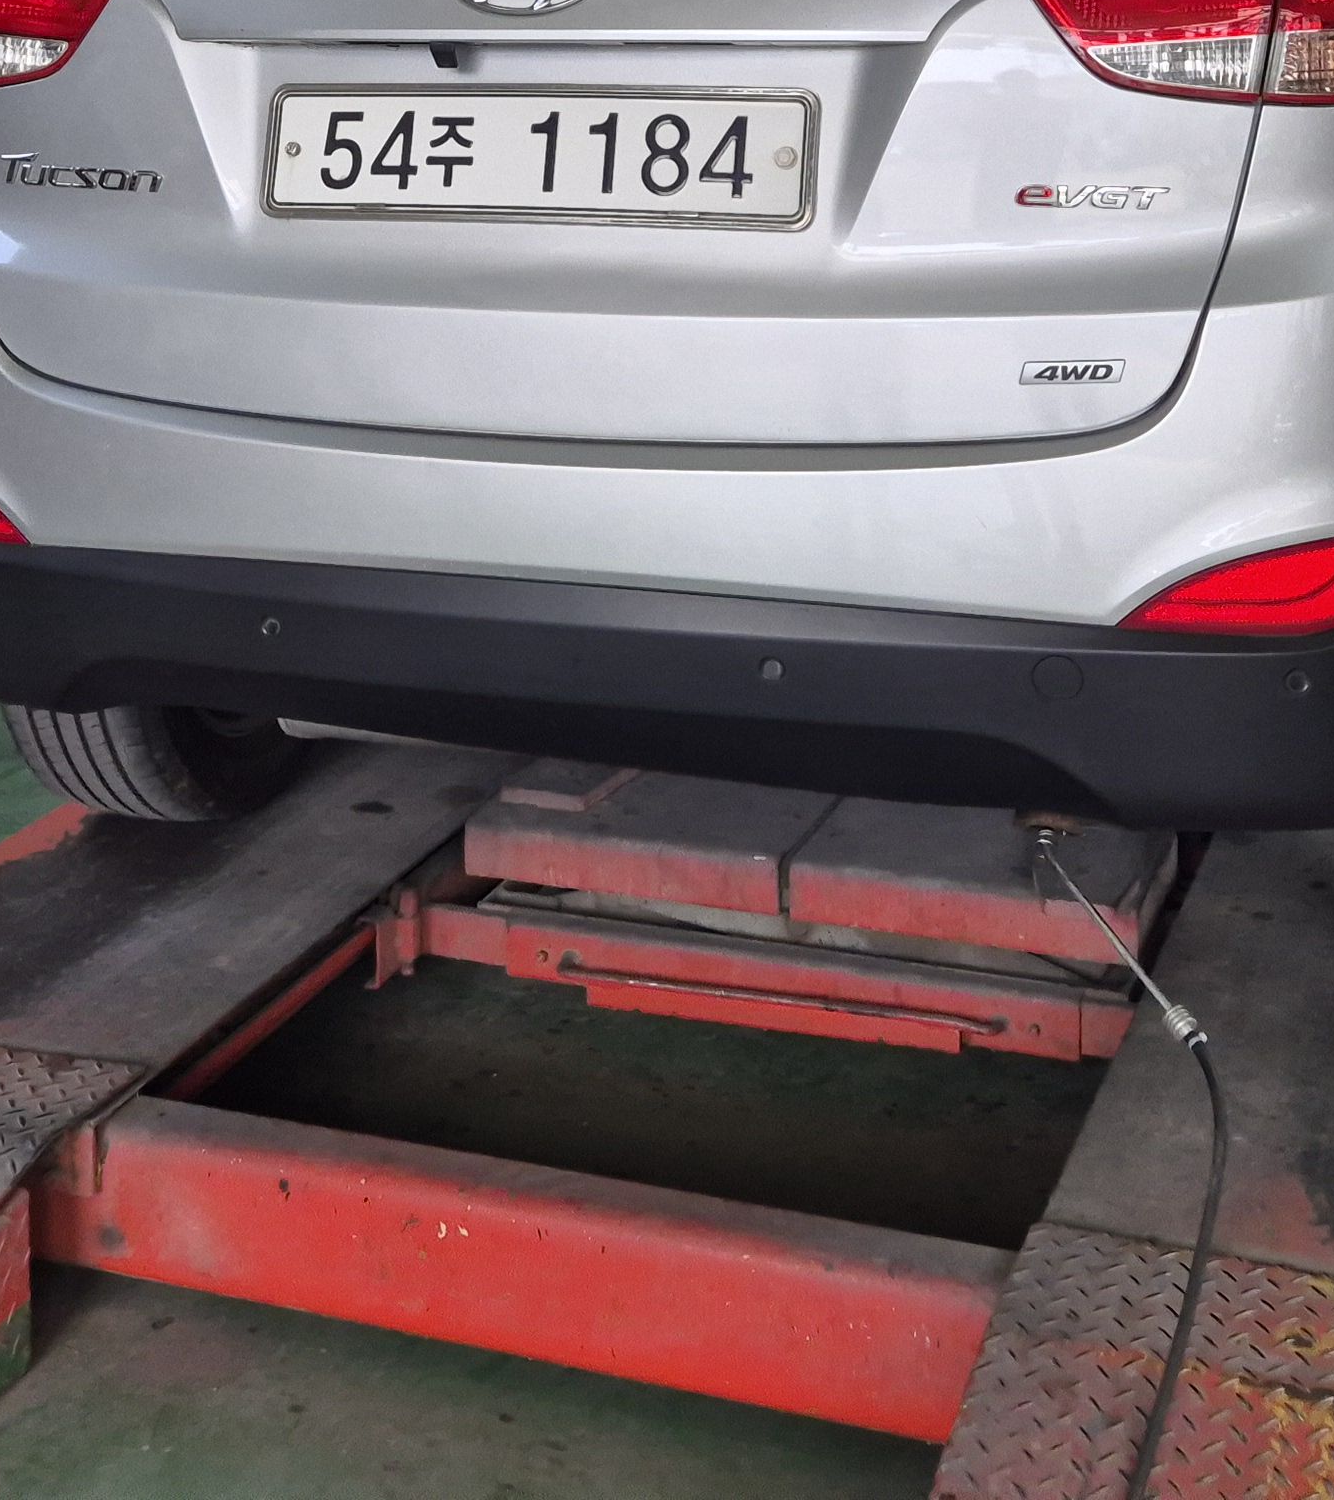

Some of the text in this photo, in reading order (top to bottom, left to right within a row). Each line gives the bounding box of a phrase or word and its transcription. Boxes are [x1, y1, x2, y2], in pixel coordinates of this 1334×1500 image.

[320, 110, 754, 199] 54주 1184
[0, 152, 163, 193] Tucson
[1014, 184, 1170, 210] eVGT
[1033, 364, 1114, 381] 4WD
